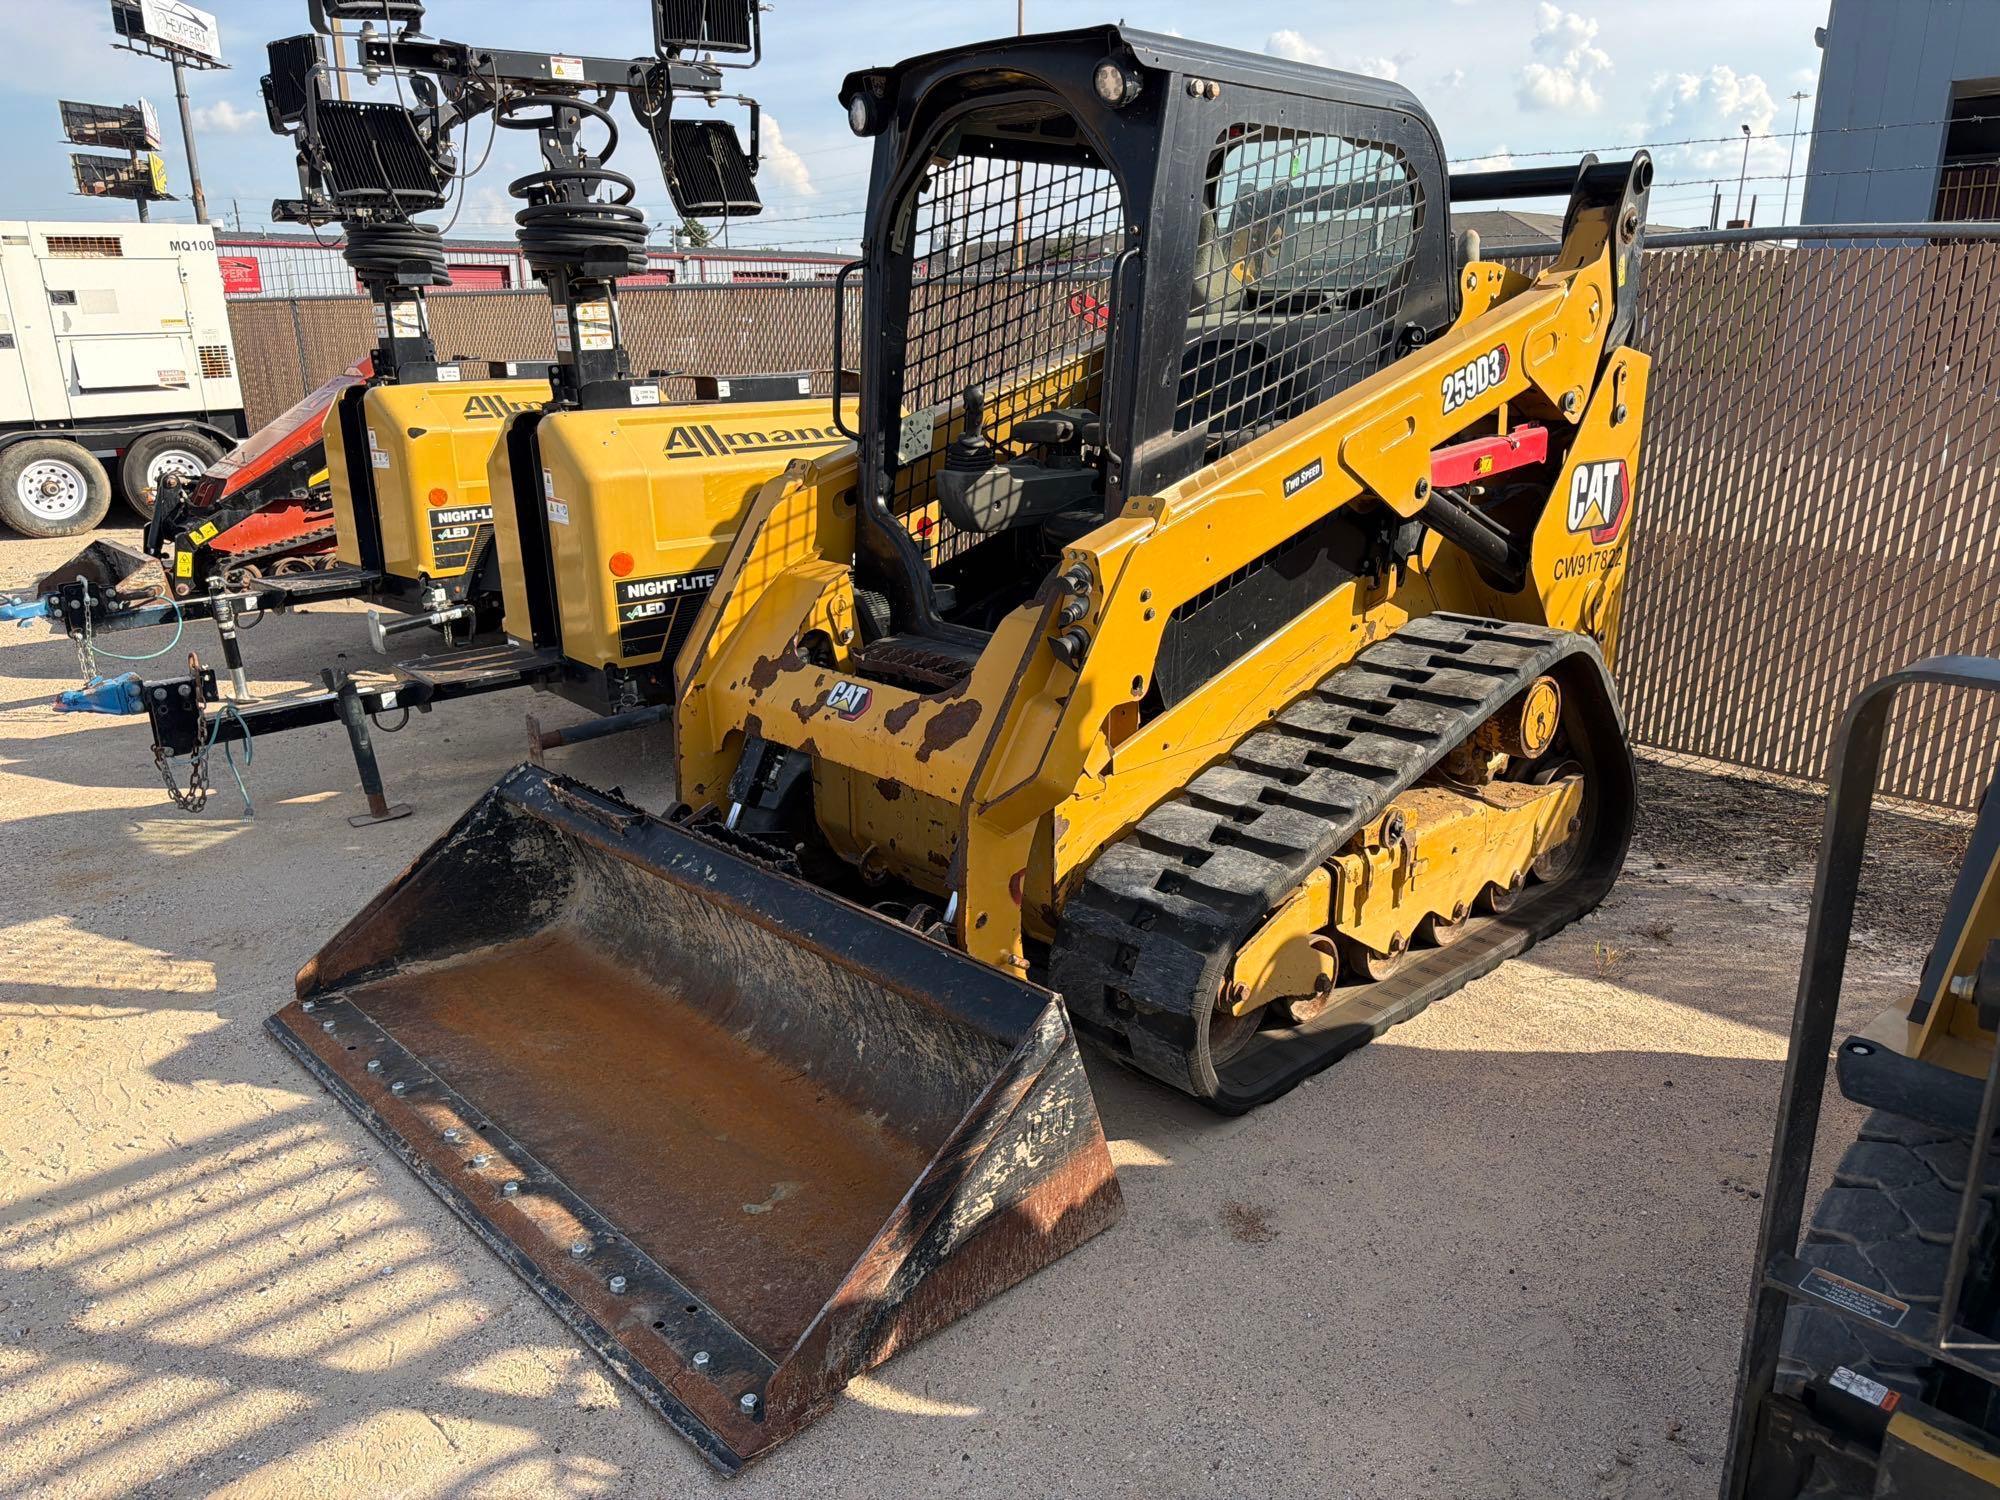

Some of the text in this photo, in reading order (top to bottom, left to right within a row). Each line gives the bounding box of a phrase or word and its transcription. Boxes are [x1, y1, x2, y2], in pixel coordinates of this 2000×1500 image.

[168, 18, 206, 43] EXPERT
[169, 240, 215, 252] MQ100
[1442, 348, 1500, 414] 259D3
[1567, 461, 1620, 531] CAT
[446, 526, 470, 539] LED
[1553, 546, 1623, 581] CW917822
[627, 574, 716, 599] NIGHT-LITE
[638, 602, 667, 618] LED
[826, 681, 869, 713] CAT
